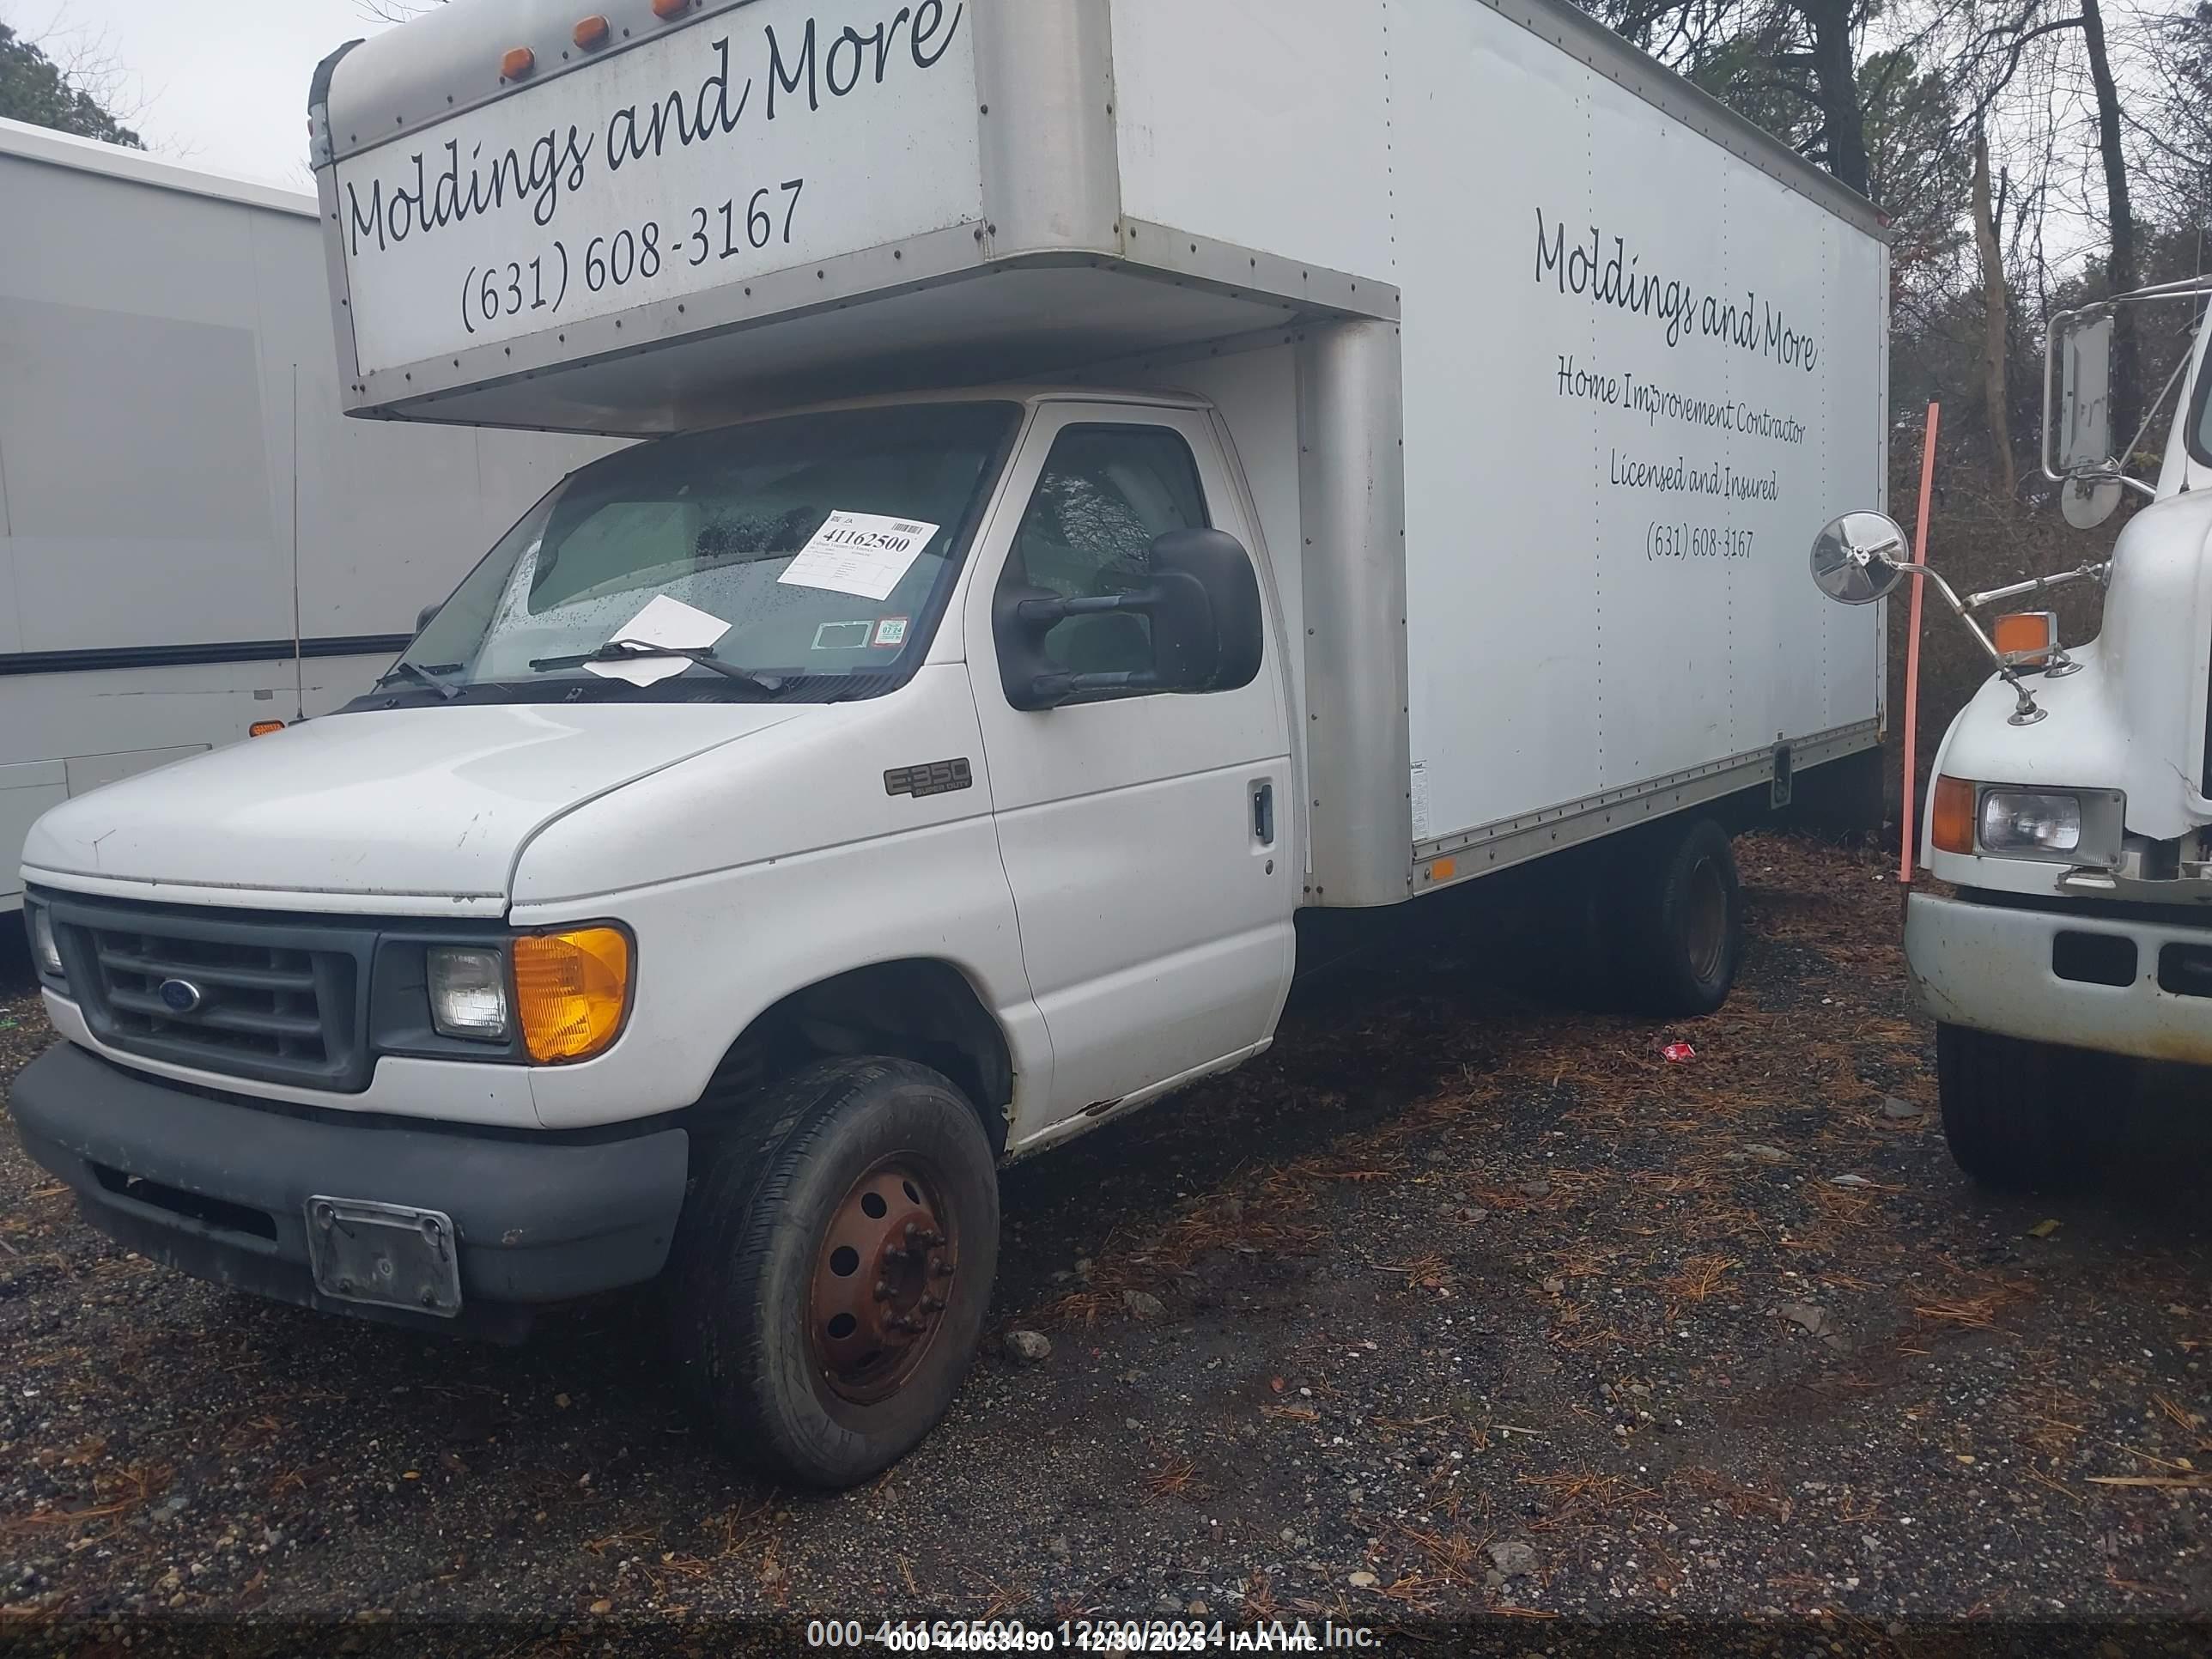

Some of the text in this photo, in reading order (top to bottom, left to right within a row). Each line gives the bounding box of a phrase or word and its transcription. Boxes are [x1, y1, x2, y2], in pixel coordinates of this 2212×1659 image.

[347, 0, 965, 257] Moldings and More
[461, 178, 804, 333] (631) 608-3167
[1535, 207, 1818, 372] Moldings and More
[1557, 355, 1806, 445] Home Improvement Contractor
[1610, 448, 1779, 501] Licensed and Insured
[823, 528, 910, 552] 41162500
[1646, 521, 1753, 561] (631) 608-3167
